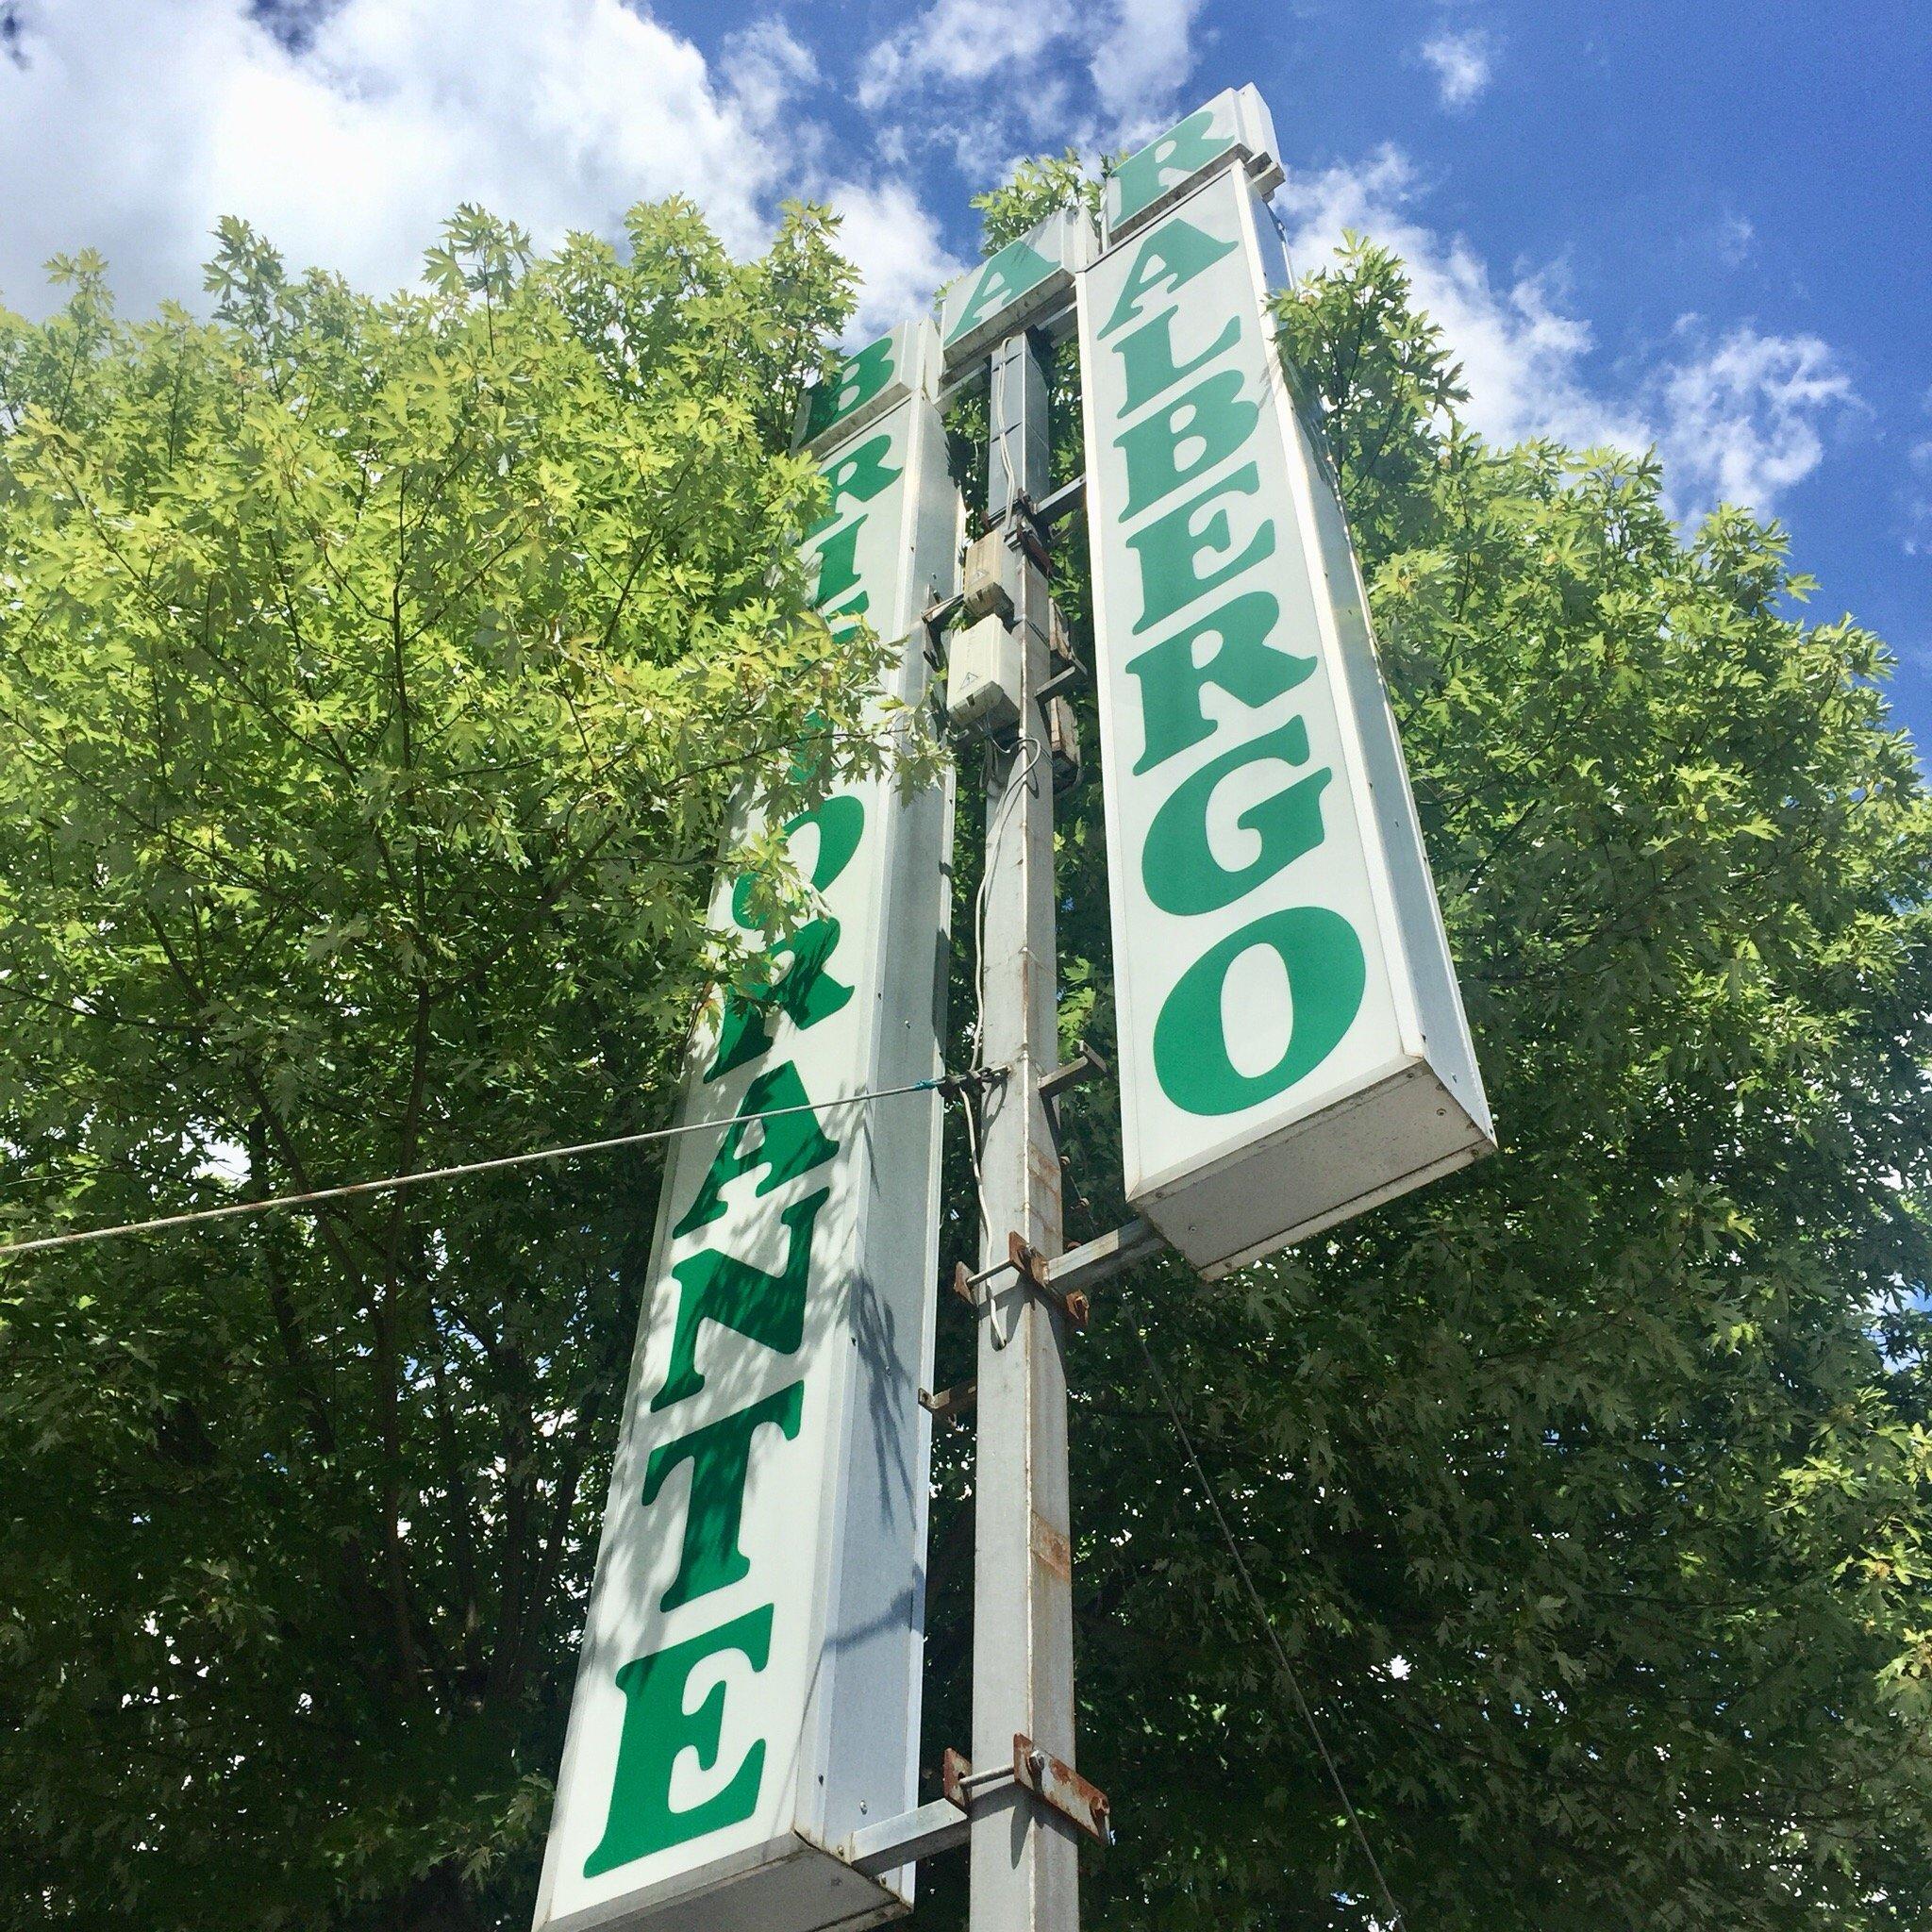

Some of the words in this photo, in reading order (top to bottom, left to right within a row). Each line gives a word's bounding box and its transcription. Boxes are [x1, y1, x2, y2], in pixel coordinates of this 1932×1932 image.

[797, 110, 1234, 448] BAR
[1097, 218, 1366, 1116] ALBERGO
[583, 434, 904, 1879] RIORANTE
